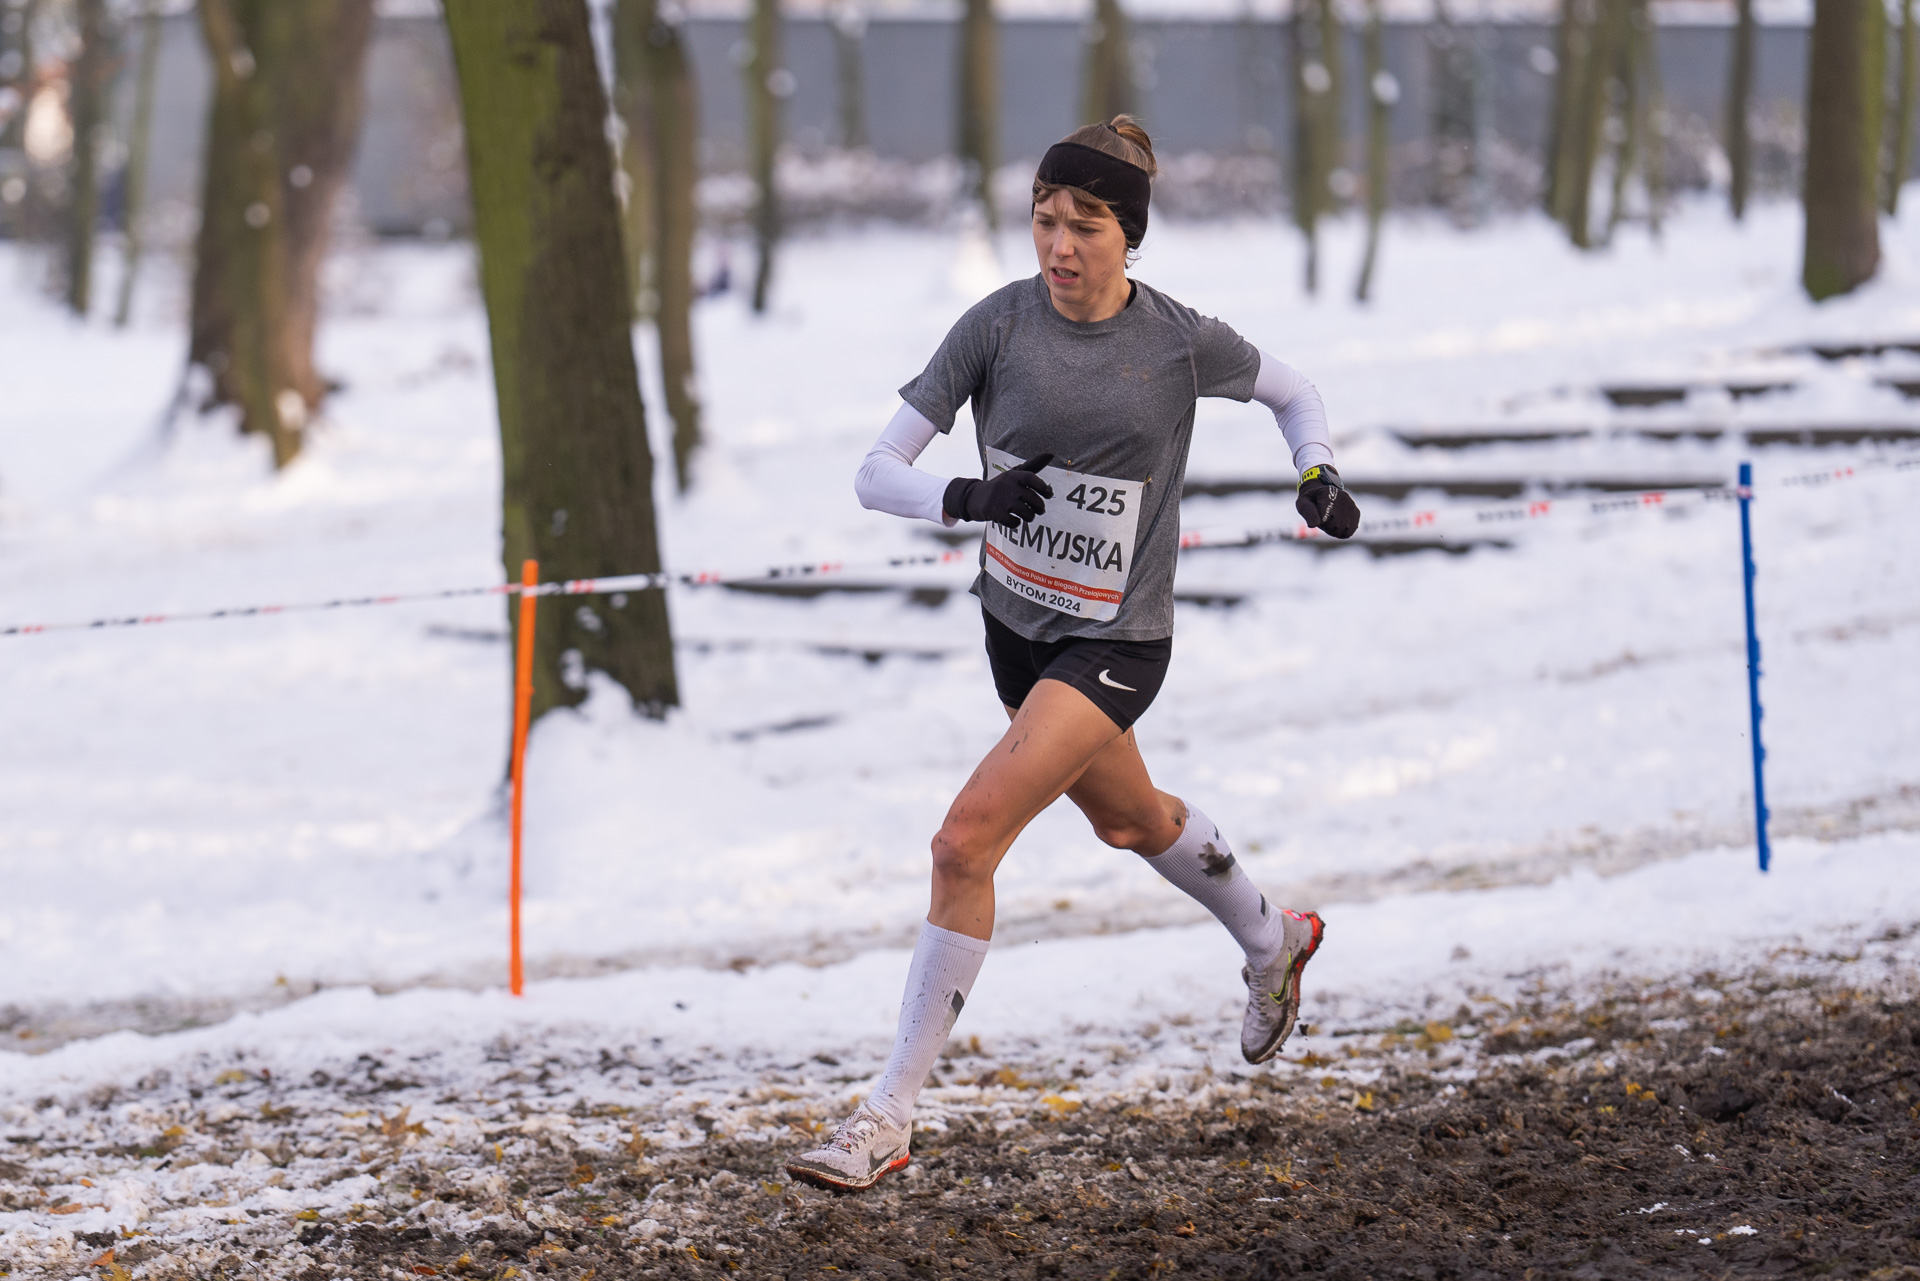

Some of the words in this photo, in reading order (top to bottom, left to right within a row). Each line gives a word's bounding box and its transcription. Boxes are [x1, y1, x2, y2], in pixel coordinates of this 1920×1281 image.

[1066, 483, 1127, 516] 425
[1006, 574, 1047, 602] BYTOM
[1048, 594, 1081, 613] 2024
[1030, 572, 1047, 584] Polski
[1053, 579, 1079, 592] Biegach
